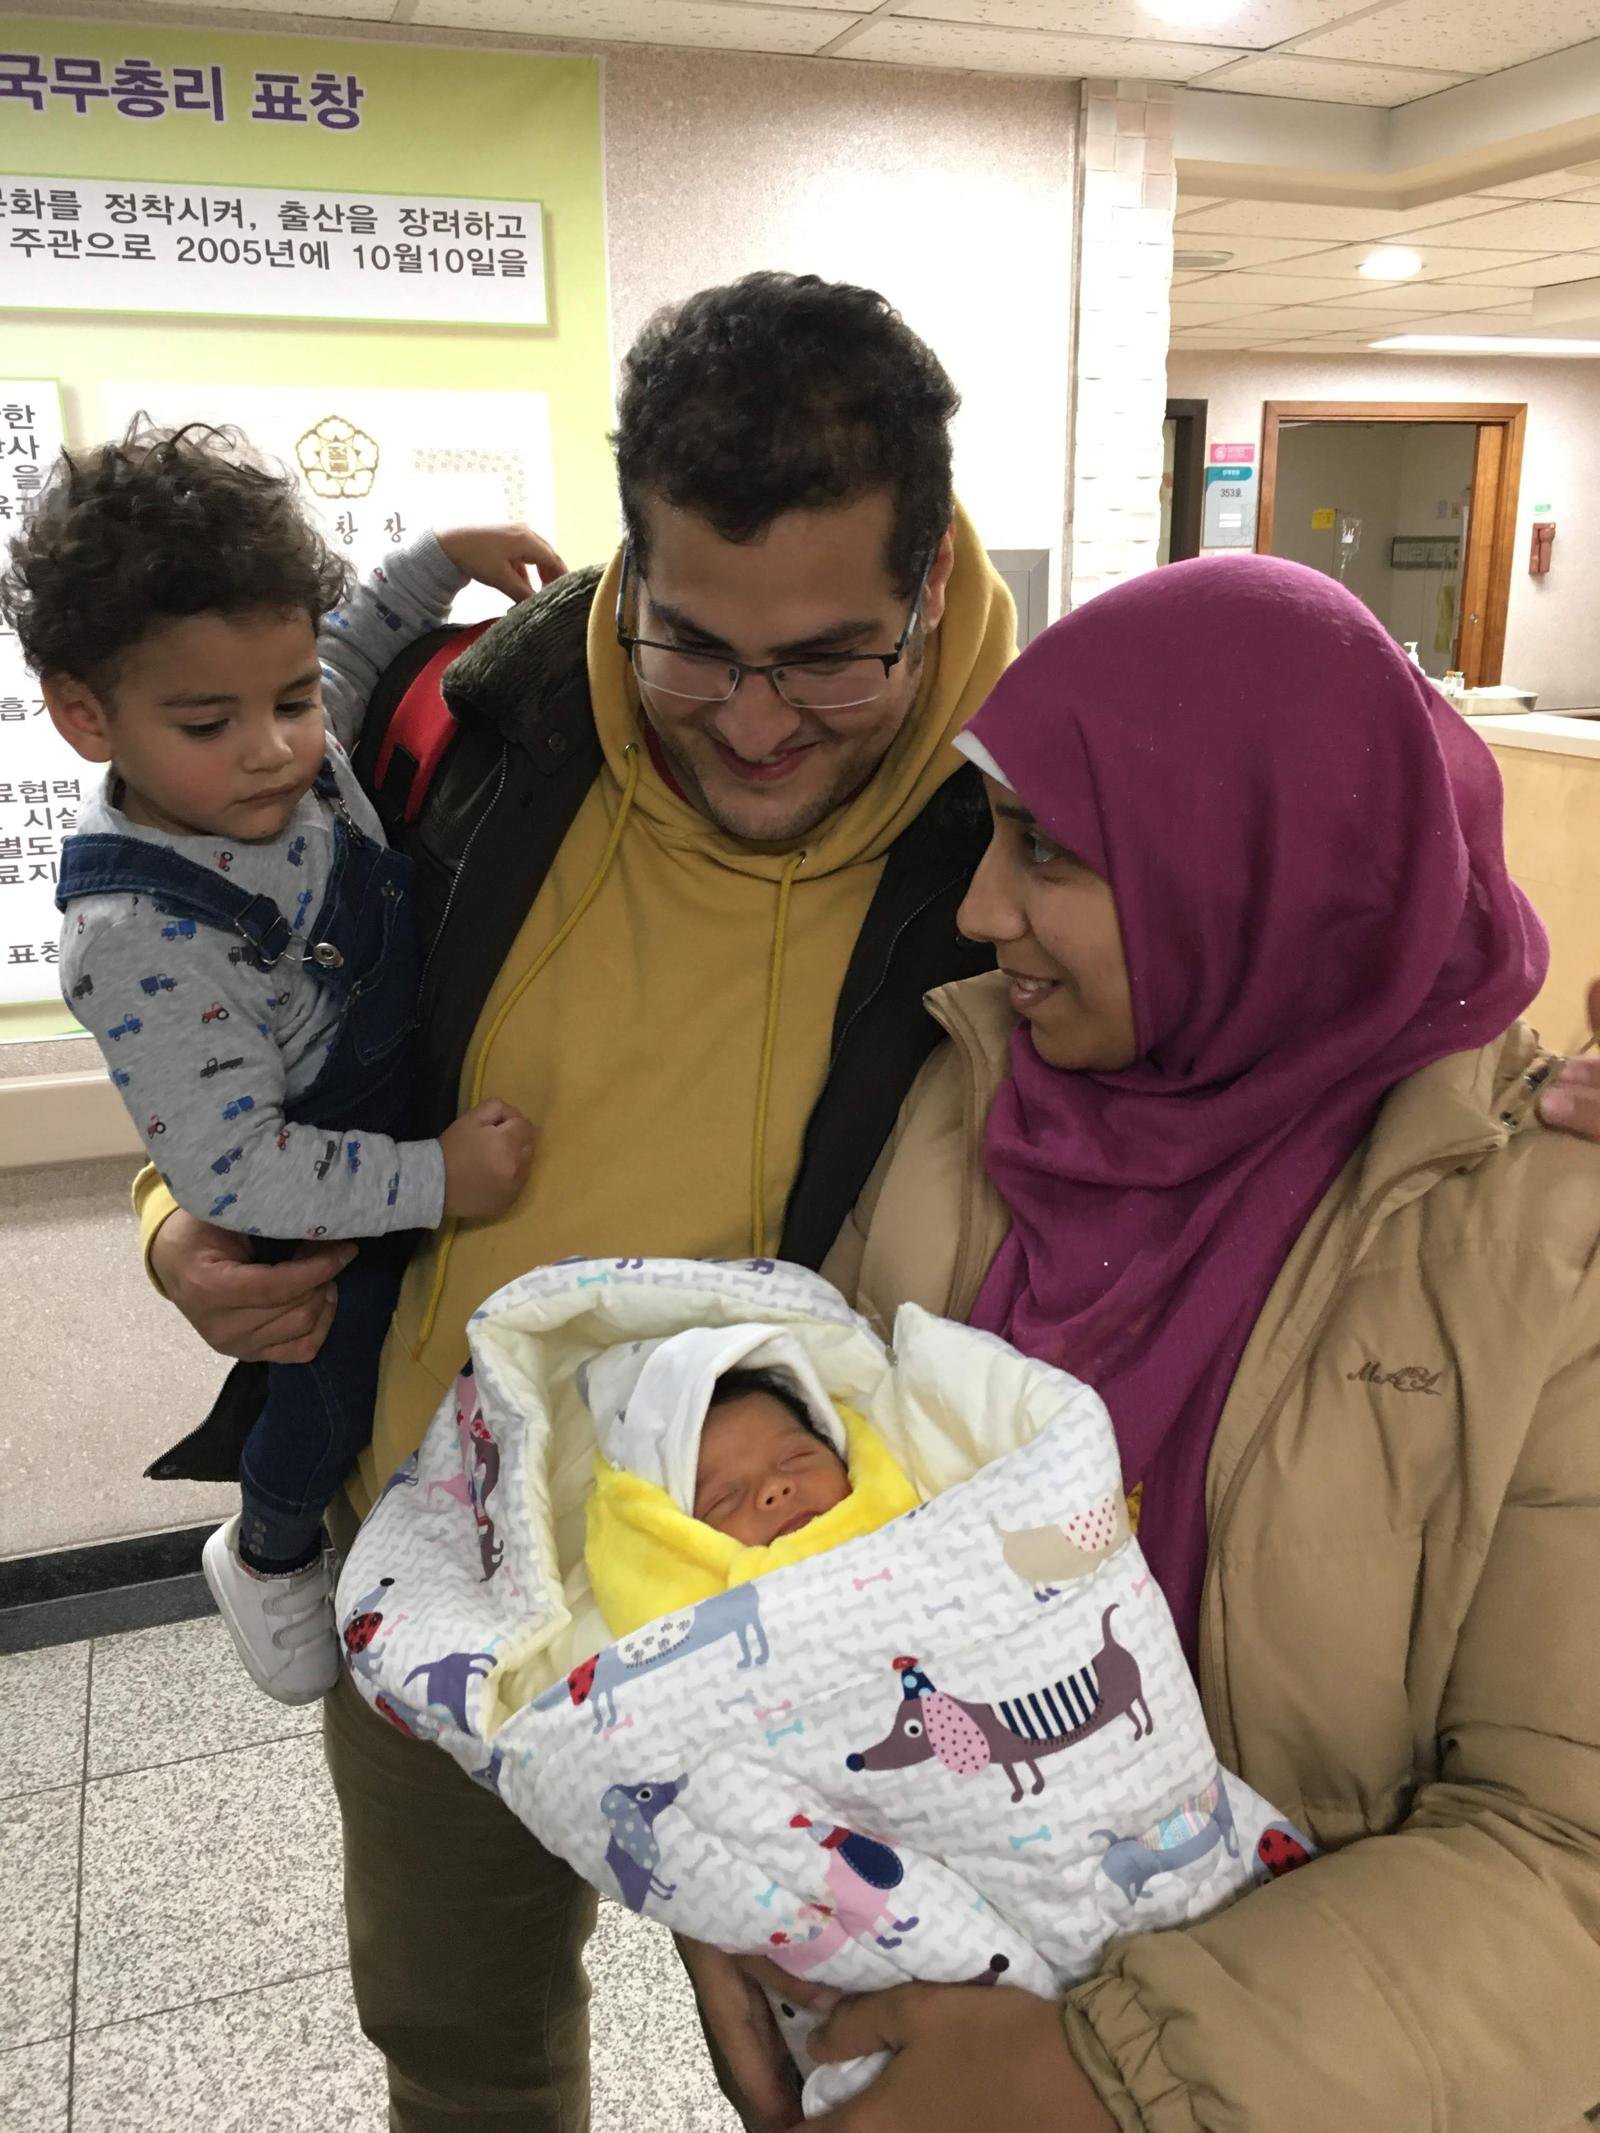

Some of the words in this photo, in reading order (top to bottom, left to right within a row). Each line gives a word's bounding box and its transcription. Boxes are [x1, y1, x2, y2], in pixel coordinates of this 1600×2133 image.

[0, 53, 224, 121] 국무총리
[252, 73, 364, 130] 표창
[0, 188, 82, 221] 화를
[104, 193, 255, 229] 정착시켜,
[277, 200, 378, 235] 출산을
[398, 207, 527, 241] 장려하고
[10, 228, 156, 260] 주관으로
[176, 236, 330, 270] 2005년에
[353, 243, 528, 278] 10월10일을
[0, 404, 36, 429] 한
[0, 435, 40, 460] 사
[336, 511, 358, 545] 창
[384, 511, 406, 543] 장
[0, 835, 67, 860] 별도
